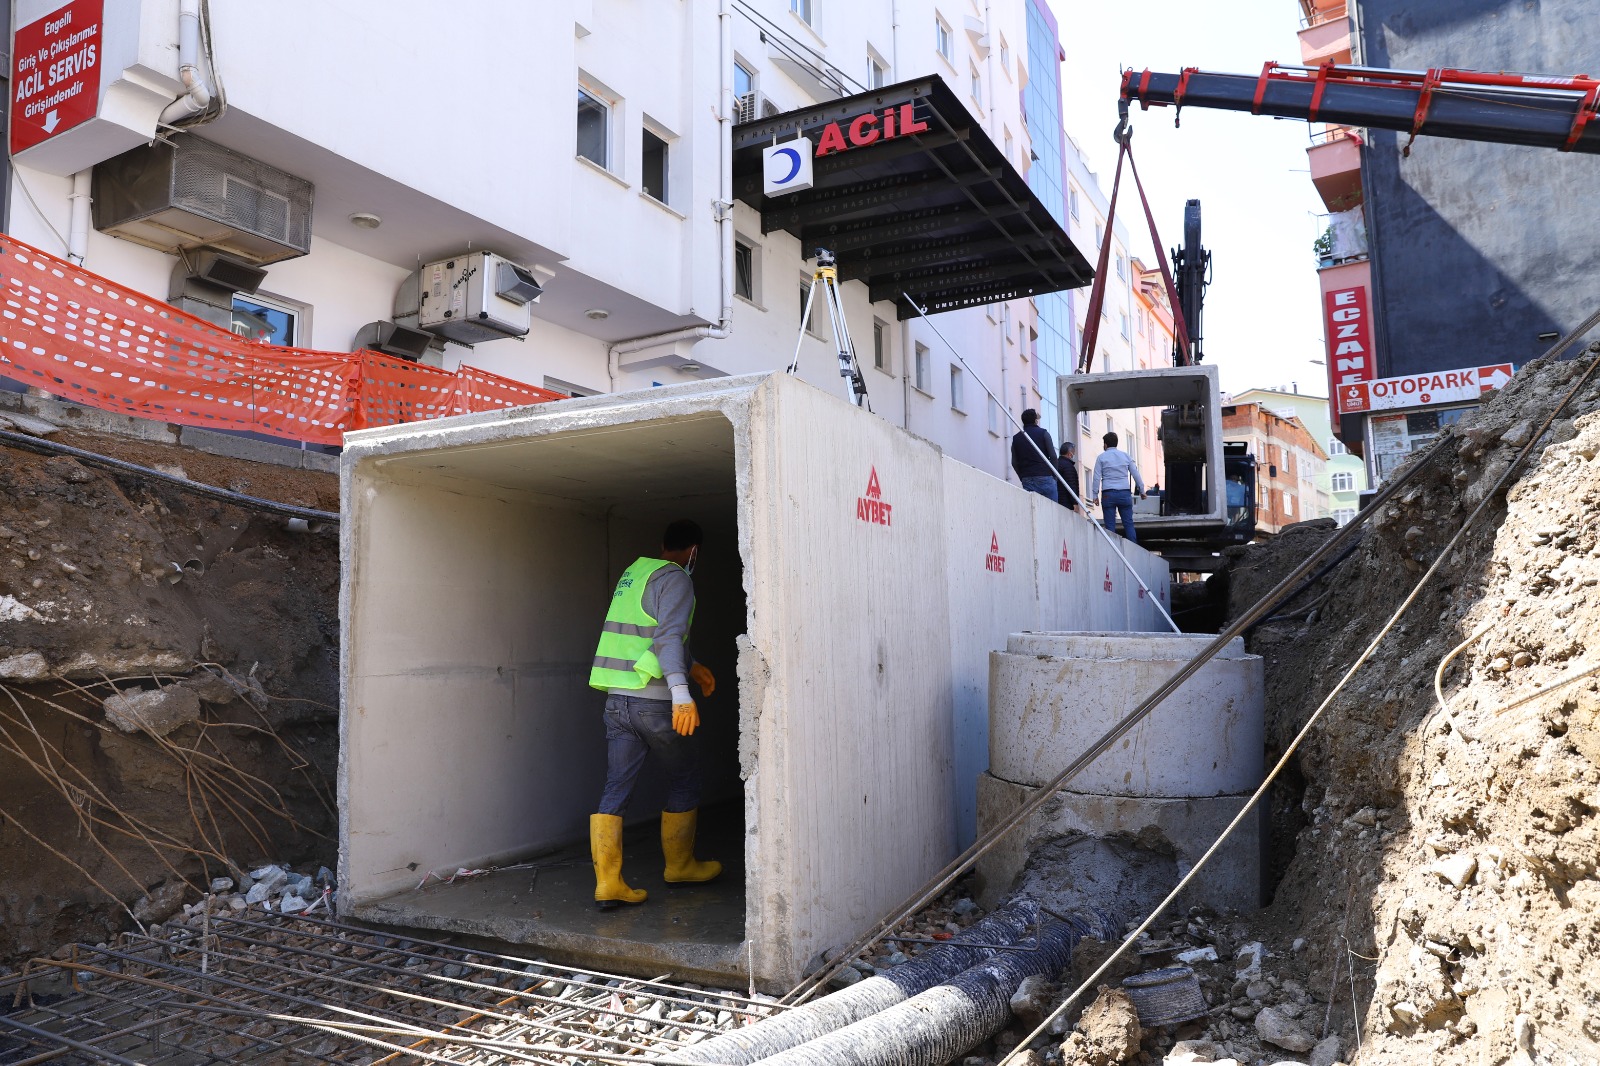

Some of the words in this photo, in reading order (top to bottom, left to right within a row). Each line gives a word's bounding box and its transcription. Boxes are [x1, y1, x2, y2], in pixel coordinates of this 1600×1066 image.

[44, 10, 72, 36] Engelli
[18, 53, 37, 73] Giriş
[38, 47, 49, 62] Ve
[50, 23, 97, 59] Çıkışlarımız
[16, 67, 44, 103] ACİL
[48, 42, 96, 87] SERVİS
[24, 80, 84, 118] Girişindendir
[935, 300, 959, 309] UMUT
[963, 291, 1017, 305] HASTANESİ
[1372, 370, 1476, 398] OTOPARK
[857, 497, 892, 527] AYBET
[985, 553, 1006, 573] AYBET
